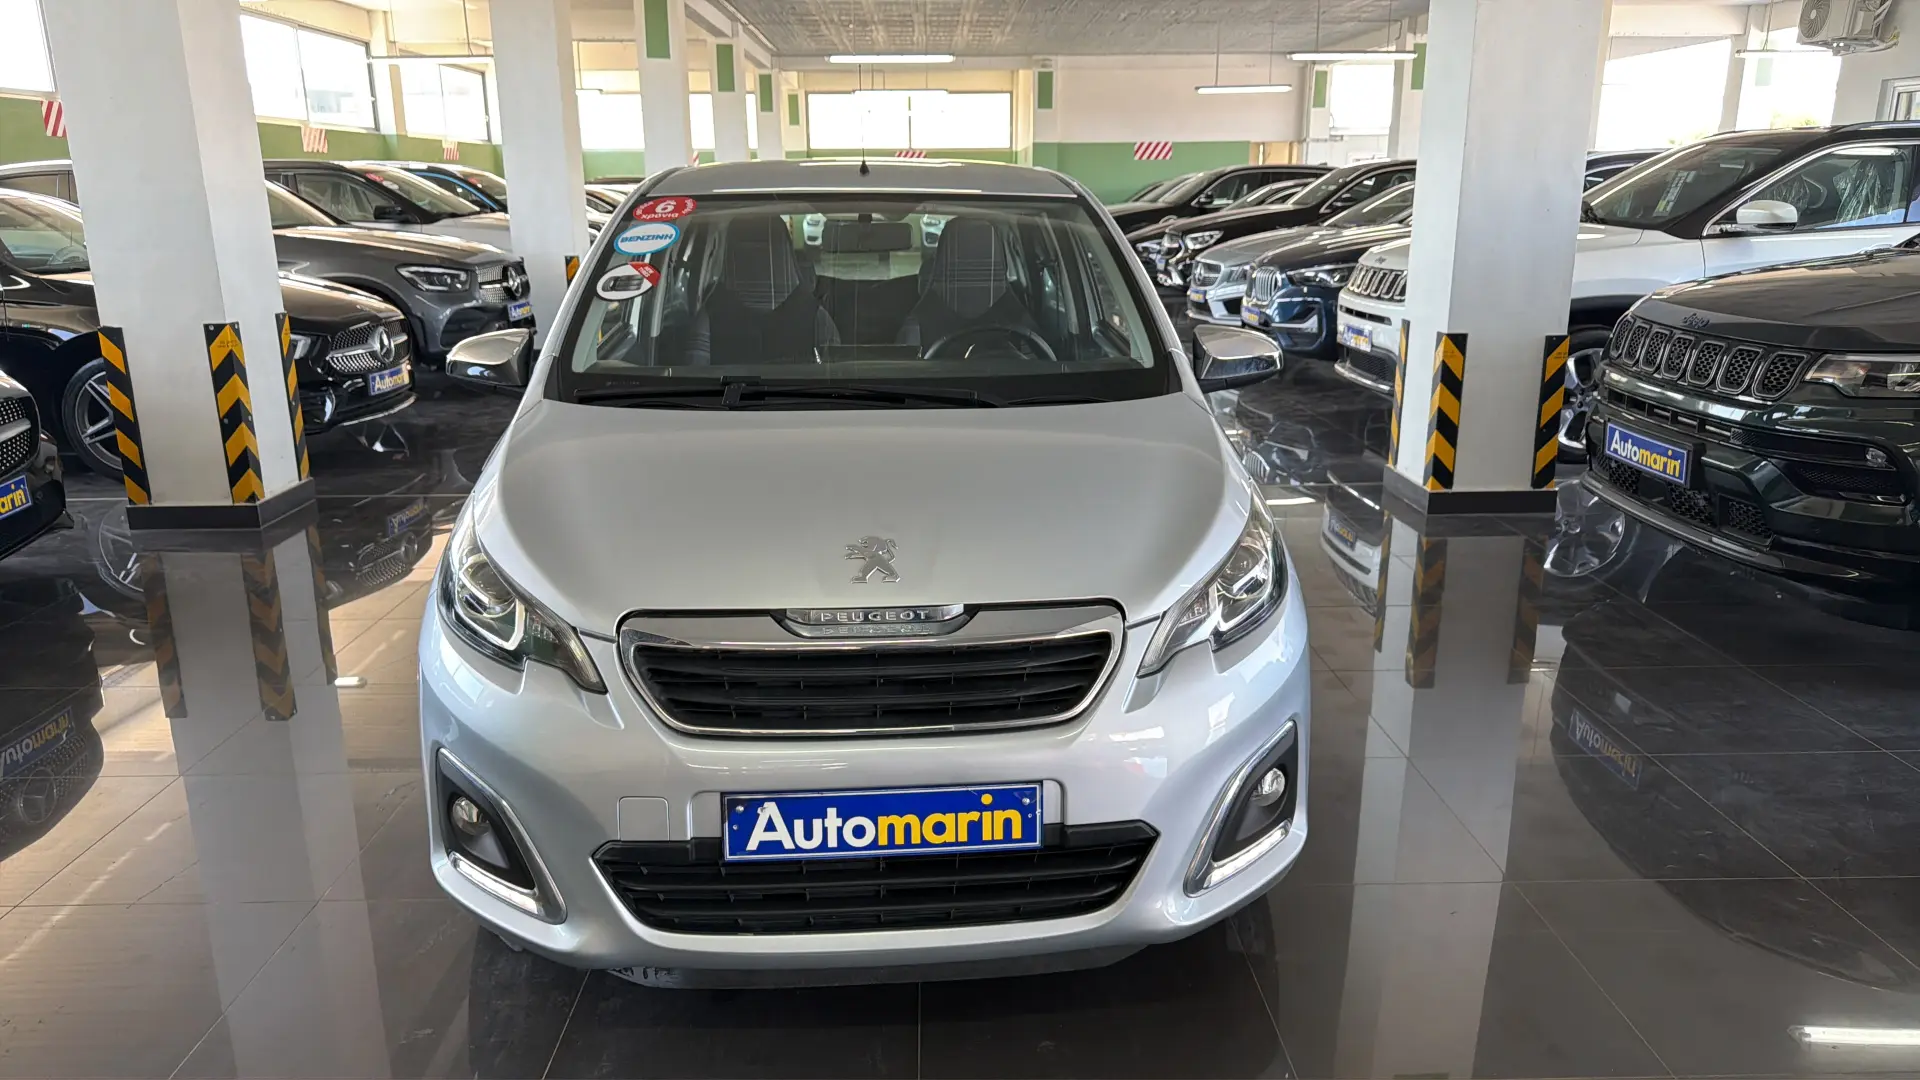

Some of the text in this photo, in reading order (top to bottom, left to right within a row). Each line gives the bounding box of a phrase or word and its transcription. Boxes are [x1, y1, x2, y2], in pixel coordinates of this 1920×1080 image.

[655, 201, 677, 214] 6
[1610, 429, 1681, 478] Automarin
[820, 609, 930, 623] PEUGEOT
[744, 793, 1022, 851] Automarin
